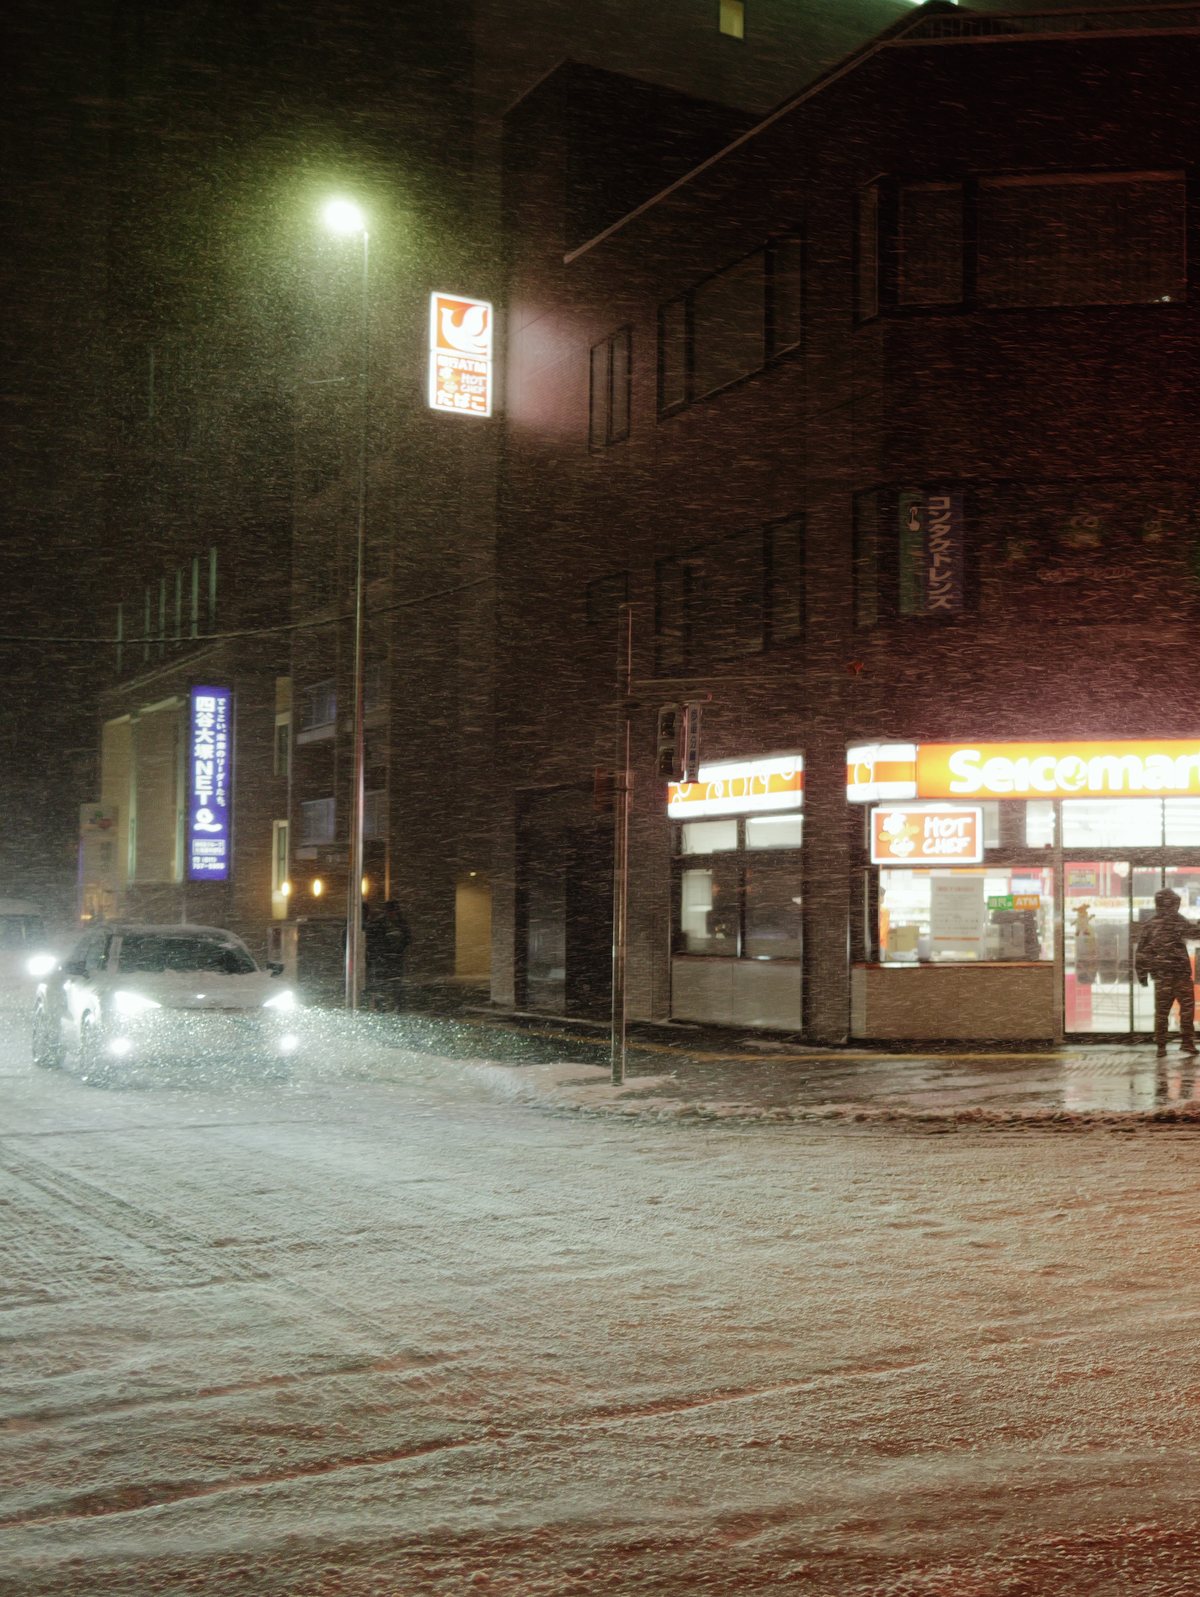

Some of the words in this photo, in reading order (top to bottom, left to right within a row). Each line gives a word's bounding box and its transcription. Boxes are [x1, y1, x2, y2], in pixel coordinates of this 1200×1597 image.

[437, 390, 486, 411] たばこ
[928, 496, 953, 609] コンタクトレンズ
[194, 696, 216, 806] 四谷大塚NET
[923, 816, 973, 837] HOT
[922, 836, 971, 854] CHEF
[1016, 897, 1039, 907] ATM
